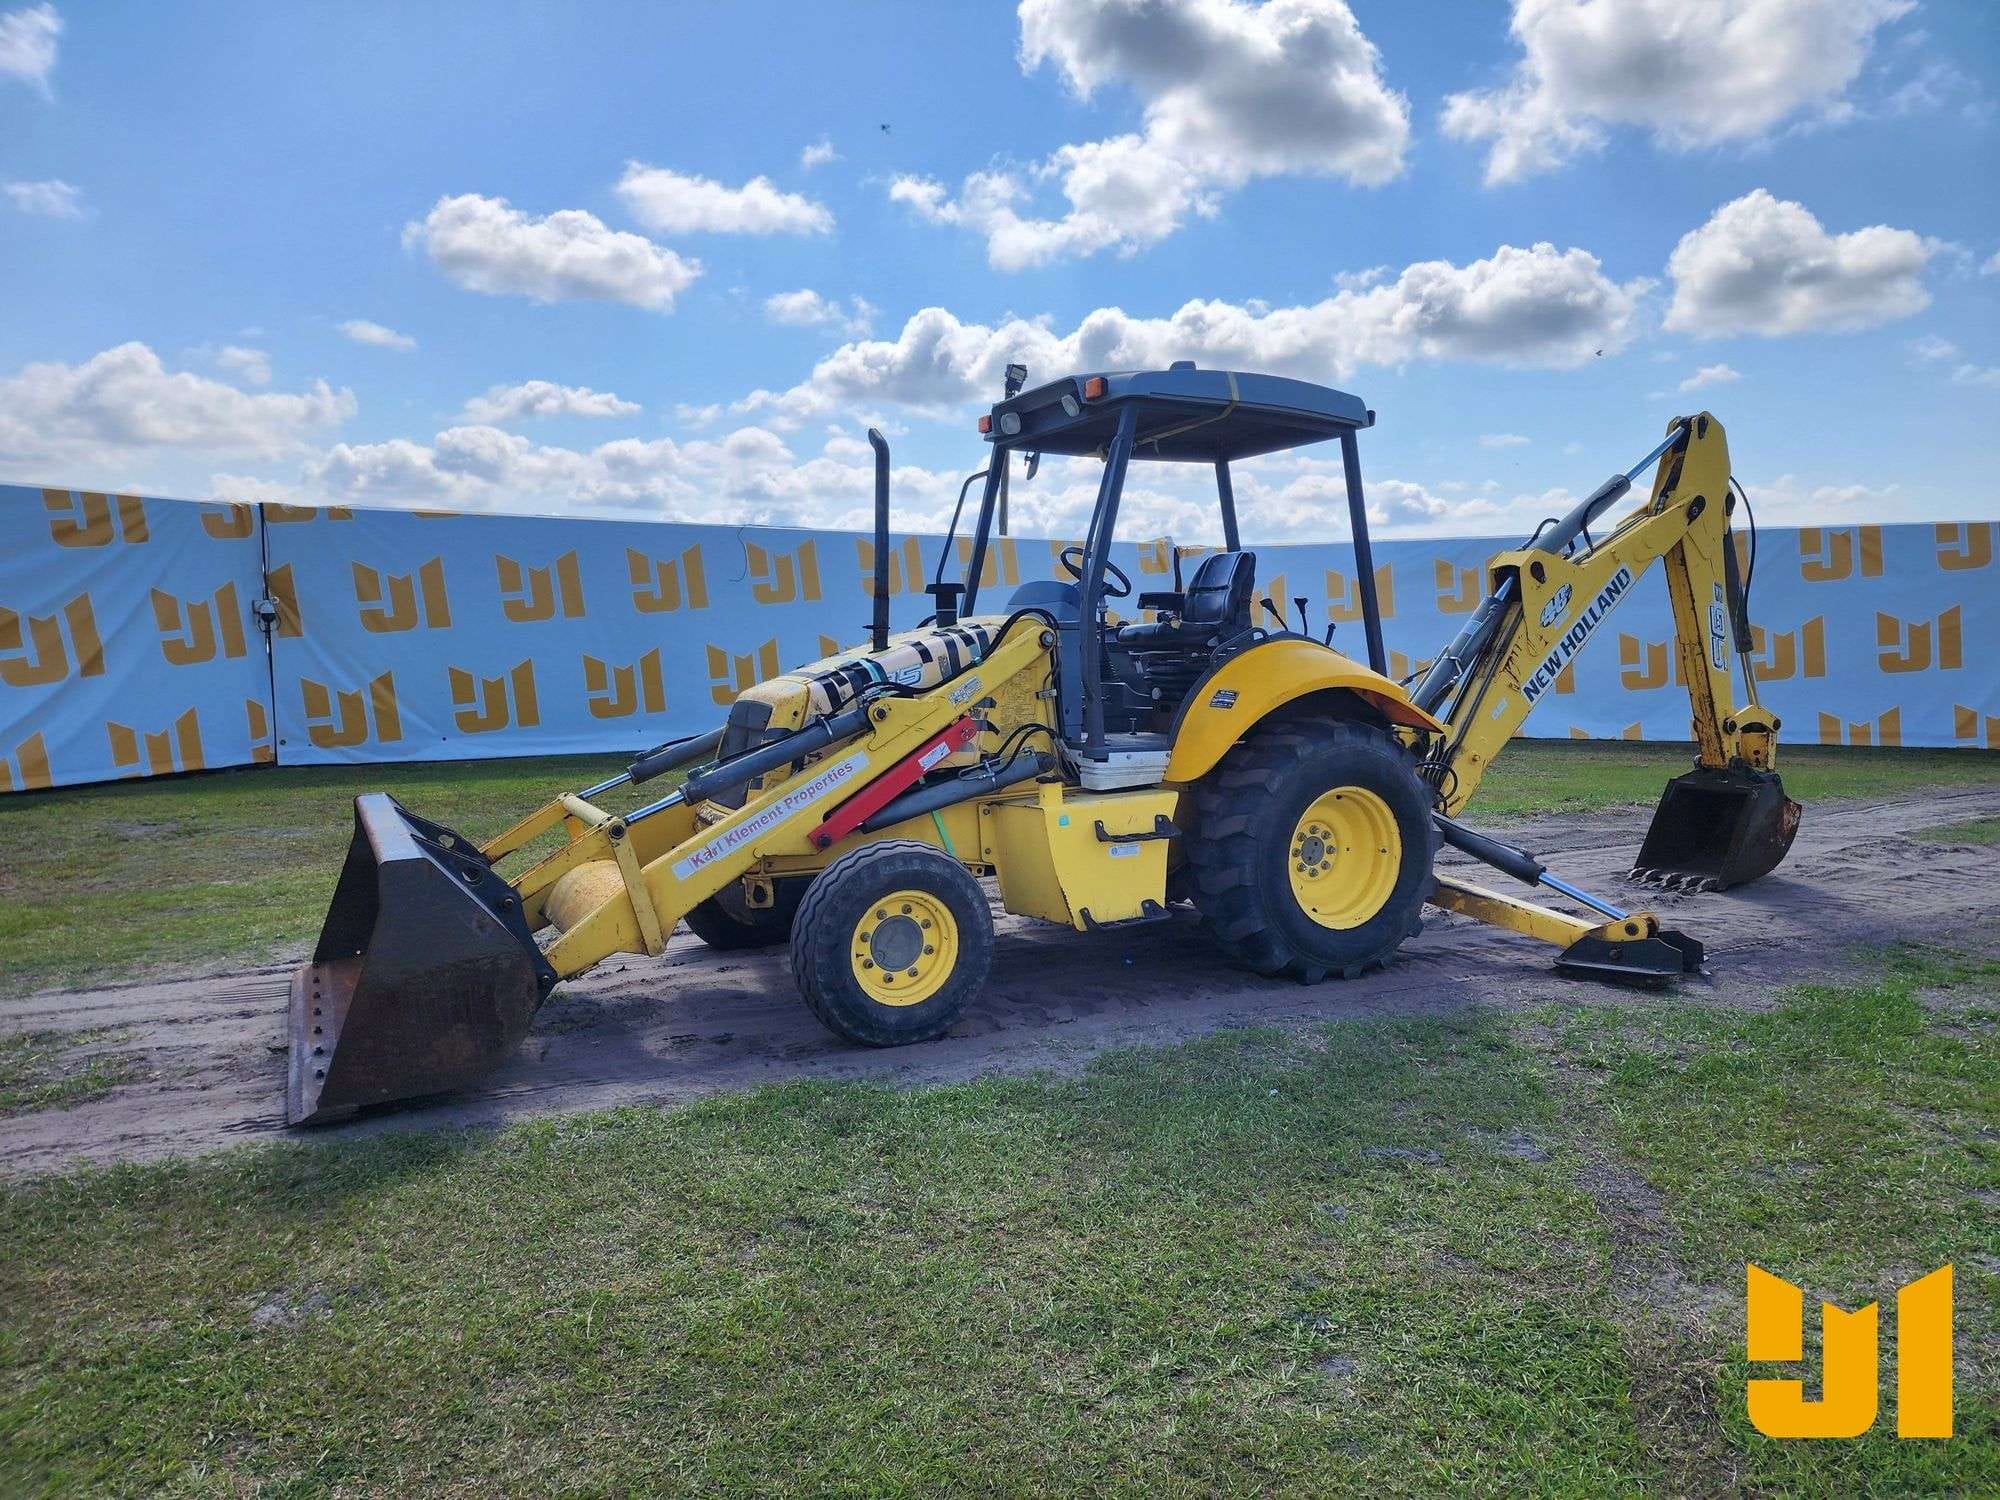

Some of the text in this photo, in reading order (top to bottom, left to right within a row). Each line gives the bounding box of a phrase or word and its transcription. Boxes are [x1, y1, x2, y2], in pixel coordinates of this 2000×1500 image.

[1523, 651, 1562, 702] NEW
[1560, 568, 1631, 658] HOLLAND
[689, 761, 854, 871] Karl Klement Properties
